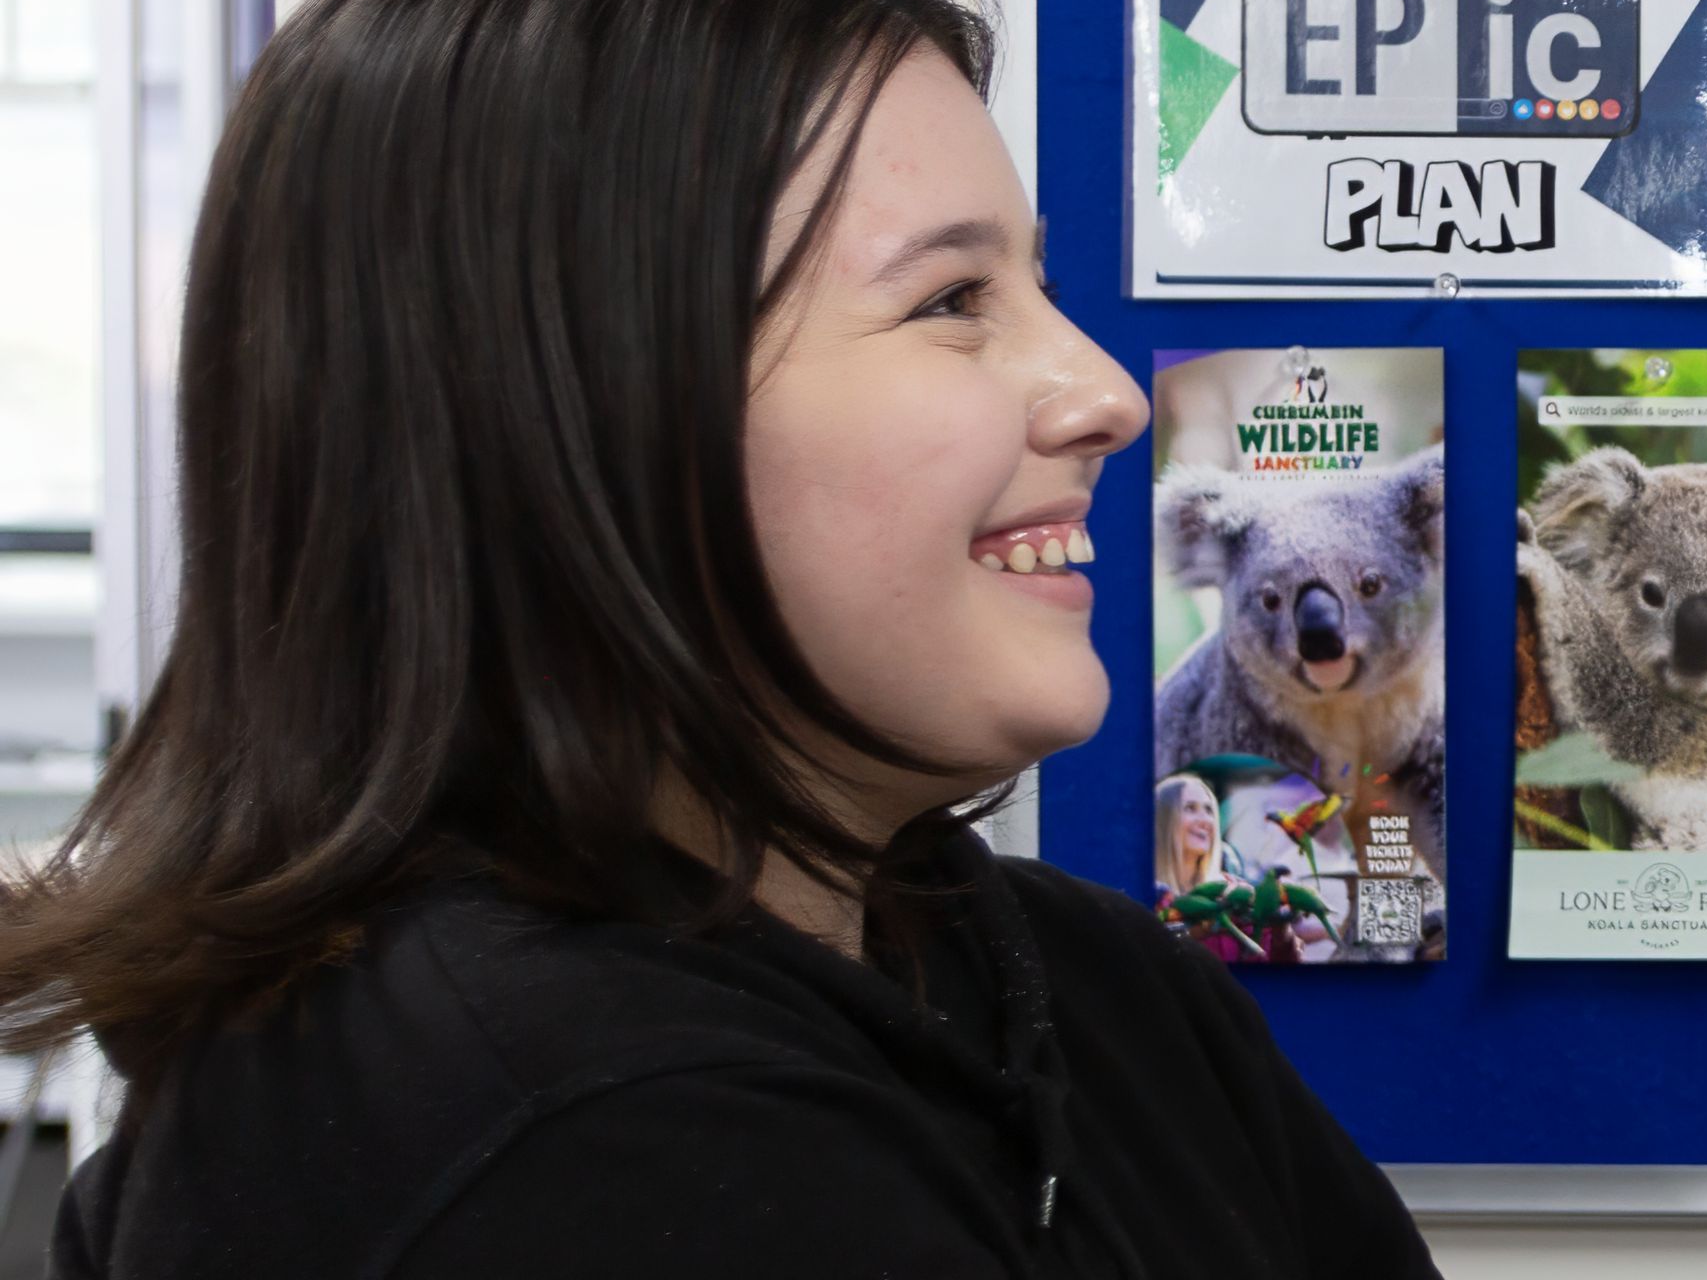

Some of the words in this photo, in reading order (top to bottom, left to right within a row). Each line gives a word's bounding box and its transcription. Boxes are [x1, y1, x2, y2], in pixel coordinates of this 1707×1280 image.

[1323, 157, 1557, 254] PLAN
[1252, 404, 1364, 420] CURRUMBIN
[1236, 422, 1380, 454] WILDLIFE
[1253, 455, 1365, 471] SANCTUARY
[1560, 891, 1625, 911] LONE
[1587, 919, 1635, 930] KOALA
